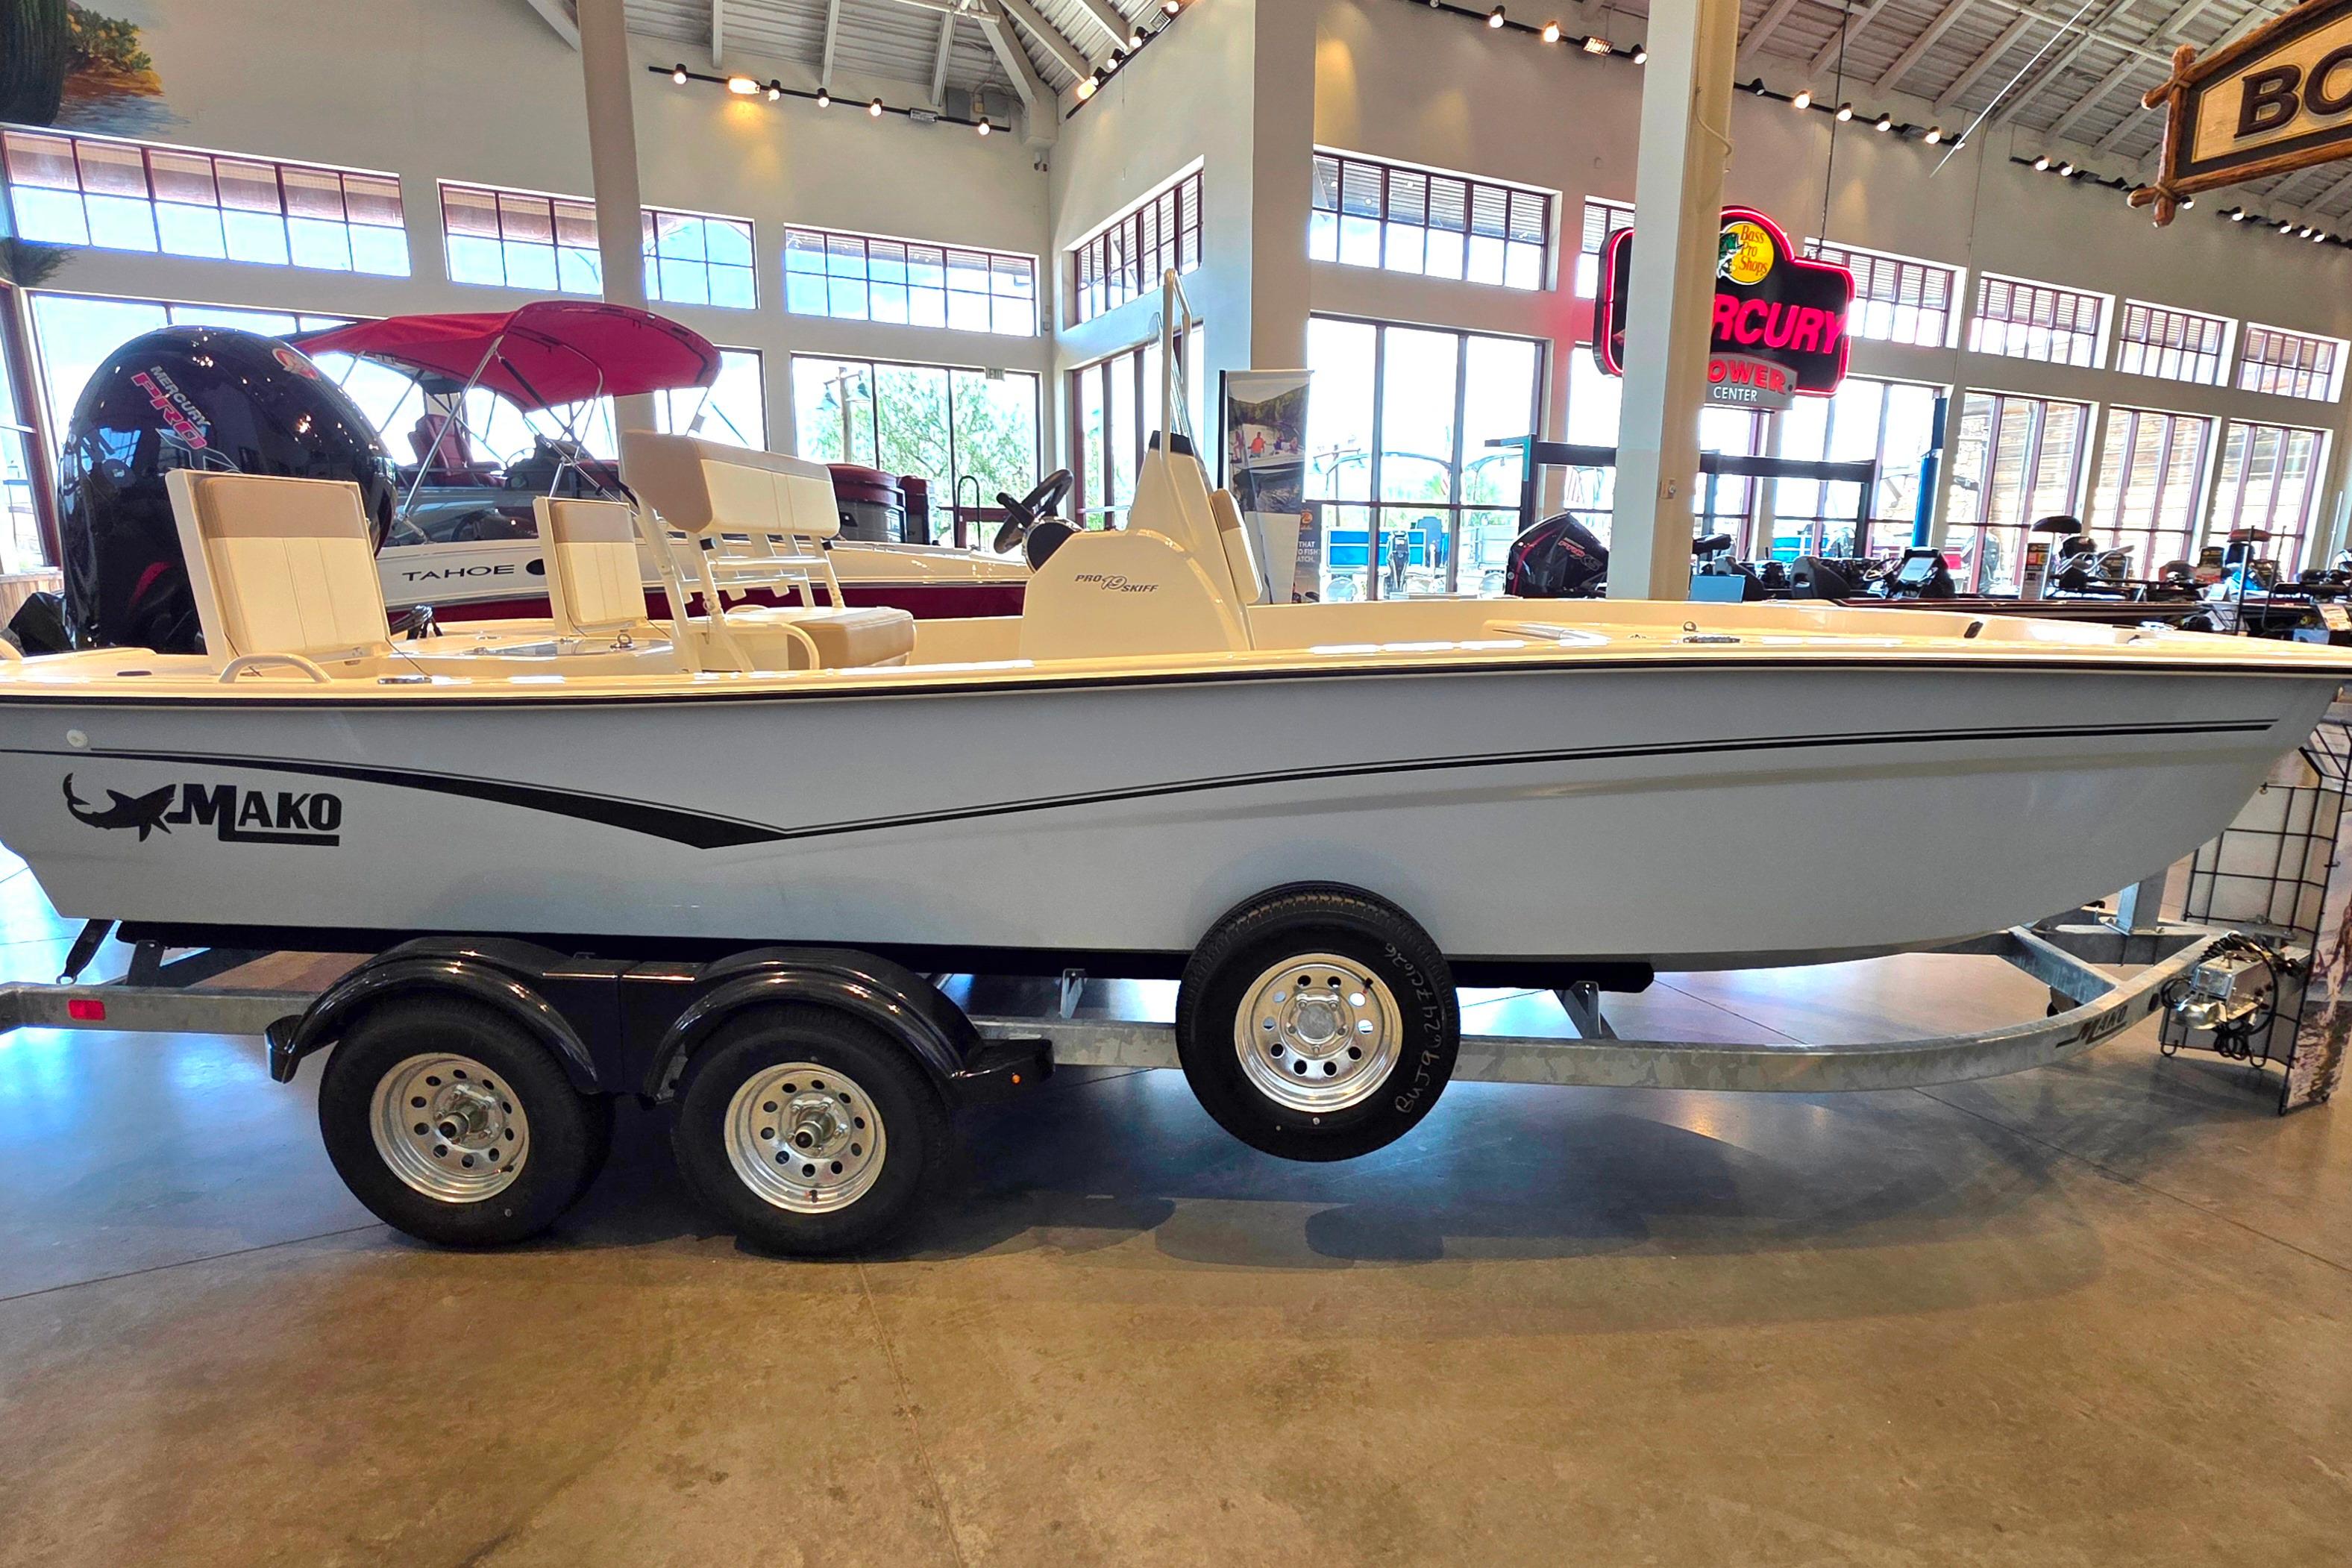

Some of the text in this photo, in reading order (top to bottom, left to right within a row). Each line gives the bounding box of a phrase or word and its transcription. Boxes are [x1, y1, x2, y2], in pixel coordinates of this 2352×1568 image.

[1740, 225, 1766, 243] Bass
[1740, 243, 1758, 257] Pro
[1738, 257, 1768, 277] Shops
[1712, 293, 1848, 354] RCURY
[1707, 359, 1786, 395] OWER
[150, 365, 211, 426] MERCURY
[1713, 386, 1757, 402] CENTER
[131, 371, 208, 450] PRO
[401, 564, 515, 582] TAHOE
[1074, 574, 1158, 592] PRO 19 SKIFF
[164, 783, 342, 846] MAKO
[2056, 1004, 2128, 1048] MAKO
